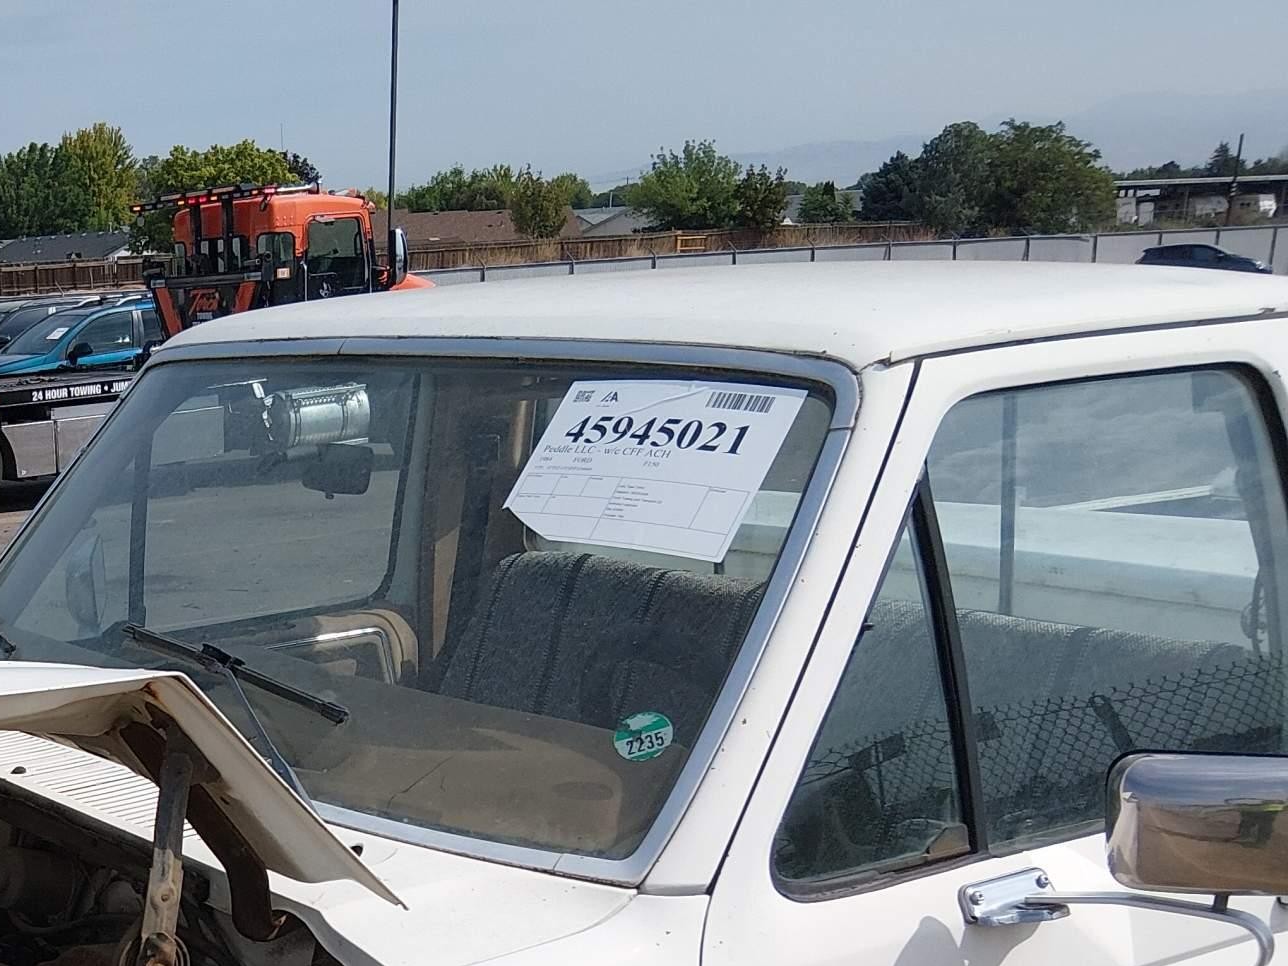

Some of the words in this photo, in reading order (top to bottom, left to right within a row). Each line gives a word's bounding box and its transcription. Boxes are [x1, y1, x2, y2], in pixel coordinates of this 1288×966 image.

[32, 390, 43, 401] 24
[45, 387, 68, 400] HOUR
[69, 384, 101, 397] TOWING
[565, 416, 750, 455] 45945021
[543, 444, 572, 454] Peddle
[574, 445, 597, 455] LLC
[644, 448, 672, 459] ACH
[626, 731, 664, 755] 2235
